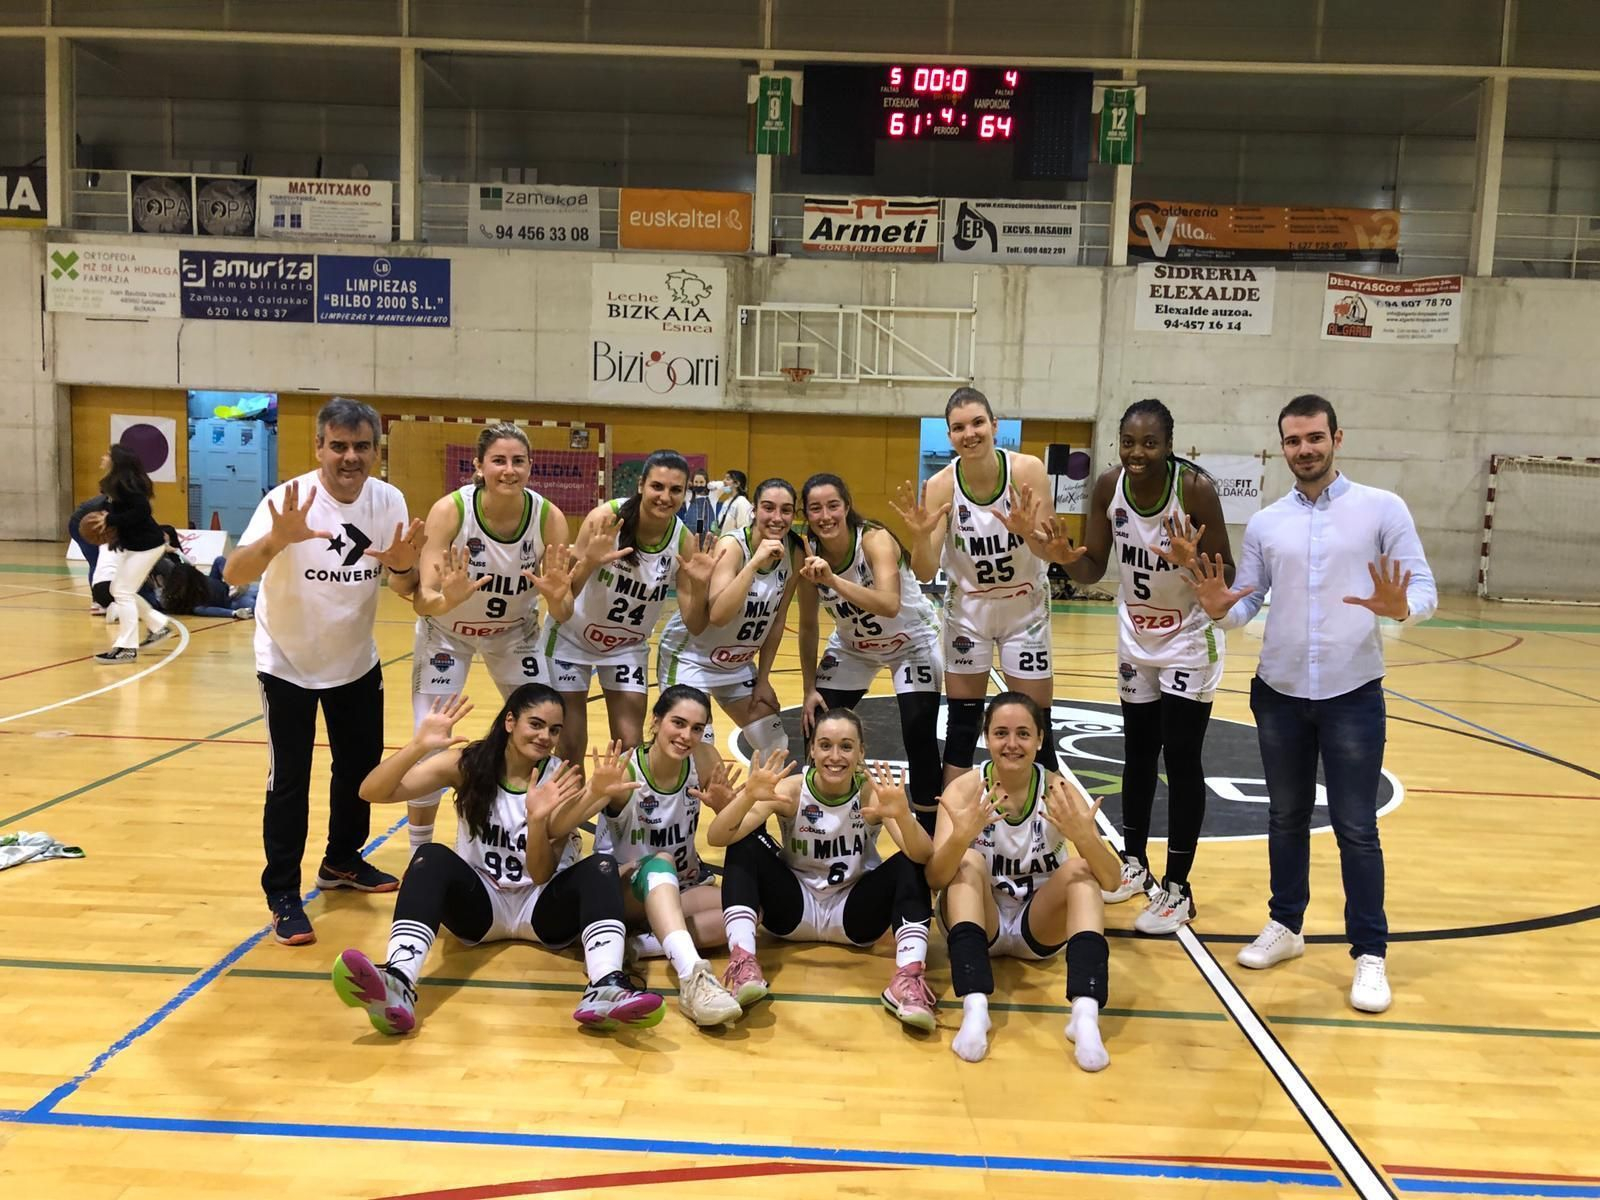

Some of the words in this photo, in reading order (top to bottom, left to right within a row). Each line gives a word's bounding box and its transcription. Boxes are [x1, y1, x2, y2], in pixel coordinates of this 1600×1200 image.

[891, 68, 902, 85] 5
[914, 68, 968, 92] 00:0
[1006, 71, 1018, 87] 4
[883, 98, 919, 108] ETXEKOAK
[974, 99, 1010, 109] KANPOKOAK
[942, 108, 953, 123] 4
[1112, 107, 1128, 130] 12
[890, 112, 921, 136] 61
[933, 127, 960, 135] PERIODO
[981, 115, 1012, 138] 64
[288, 182, 371, 197] MATXITXAKO
[505, 192, 588, 206] zamakoa
[629, 208, 721, 229] euskaltel
[495, 226, 513, 240] 94
[517, 226, 545, 241] 456
[549, 227, 566, 241] 33
[570, 227, 589, 242] 08
[809, 216, 929, 243] Armeti
[963, 220, 984, 239] EB
[1002, 225, 1033, 235] EXCVS.
[1034, 226, 1072, 236] BASAURI
[1140, 215, 1204, 258] Villa
[818, 244, 917, 253] CONSTRUCCIONES
[83, 252, 136, 262] ORTOPEDIA
[83, 264, 97, 273] MZ
[101, 265, 113, 273] DE
[117, 265, 130, 274] LA
[134, 266, 179, 276] HIDALGA
[213, 258, 313, 280] amuriza
[376, 263, 389, 273] LB
[1154, 265, 1257, 282] SIDRERIA
[83, 275, 130, 284] FARMAZIA
[346, 279, 417, 294] LIMPIEZAS
[1330, 277, 1402, 293] DESATASCOS
[189, 293, 243, 304] Zamakoa,
[258, 296, 309, 305] Galdakao
[608, 291, 658, 303] Leche
[1149, 284, 1260, 302] ELEXALDE
[376, 296, 407, 310] 2000
[1155, 304, 1209, 316] Elexalde
[1211, 309, 1253, 318] auzoa.
[1385, 300, 1399, 308] 94
[1401, 300, 1422, 309] 607
[1424, 299, 1438, 307] 78
[1439, 298, 1453, 307] 70
[207, 307, 230, 316] 620
[235, 308, 249, 317] 16
[254, 308, 268, 318] 83
[274, 309, 289, 318] 37
[320, 312, 367, 321] LIMPIEZAS
[376, 314, 448, 324] MANTENIMIENTO
[607, 304, 711, 322] BIZKAIA
[662, 322, 712, 334] Esnea
[1164, 319, 1205, 330] 94-457
[1209, 321, 1224, 330] 16
[1227, 321, 1242, 331] 14
[594, 340, 719, 394] Bizigarri
[1216, 479, 1252, 488] OSSFIT
[1216, 488, 1258, 498] LDAKAO
[975, 555, 1015, 584] 25
[476, 572, 535, 596] MILA
[1133, 571, 1151, 601] 5
[485, 597, 508, 619] 9
[606, 597, 647, 626] 24
[1132, 614, 1175, 629] eza
[521, 656, 540, 677] 9
[954, 657, 974, 666] vive
[1019, 651, 1049, 672] 25
[431, 676, 452, 685] vive
[558, 673, 577, 682] vive
[615, 664, 645, 686] 24
[904, 665, 932, 684] 15
[1171, 670, 1191, 692] 5
[1121, 685, 1137, 694] vive
[813, 834, 868, 860] MILA
[485, 851, 523, 882] 99
[827, 861, 849, 886] 6
